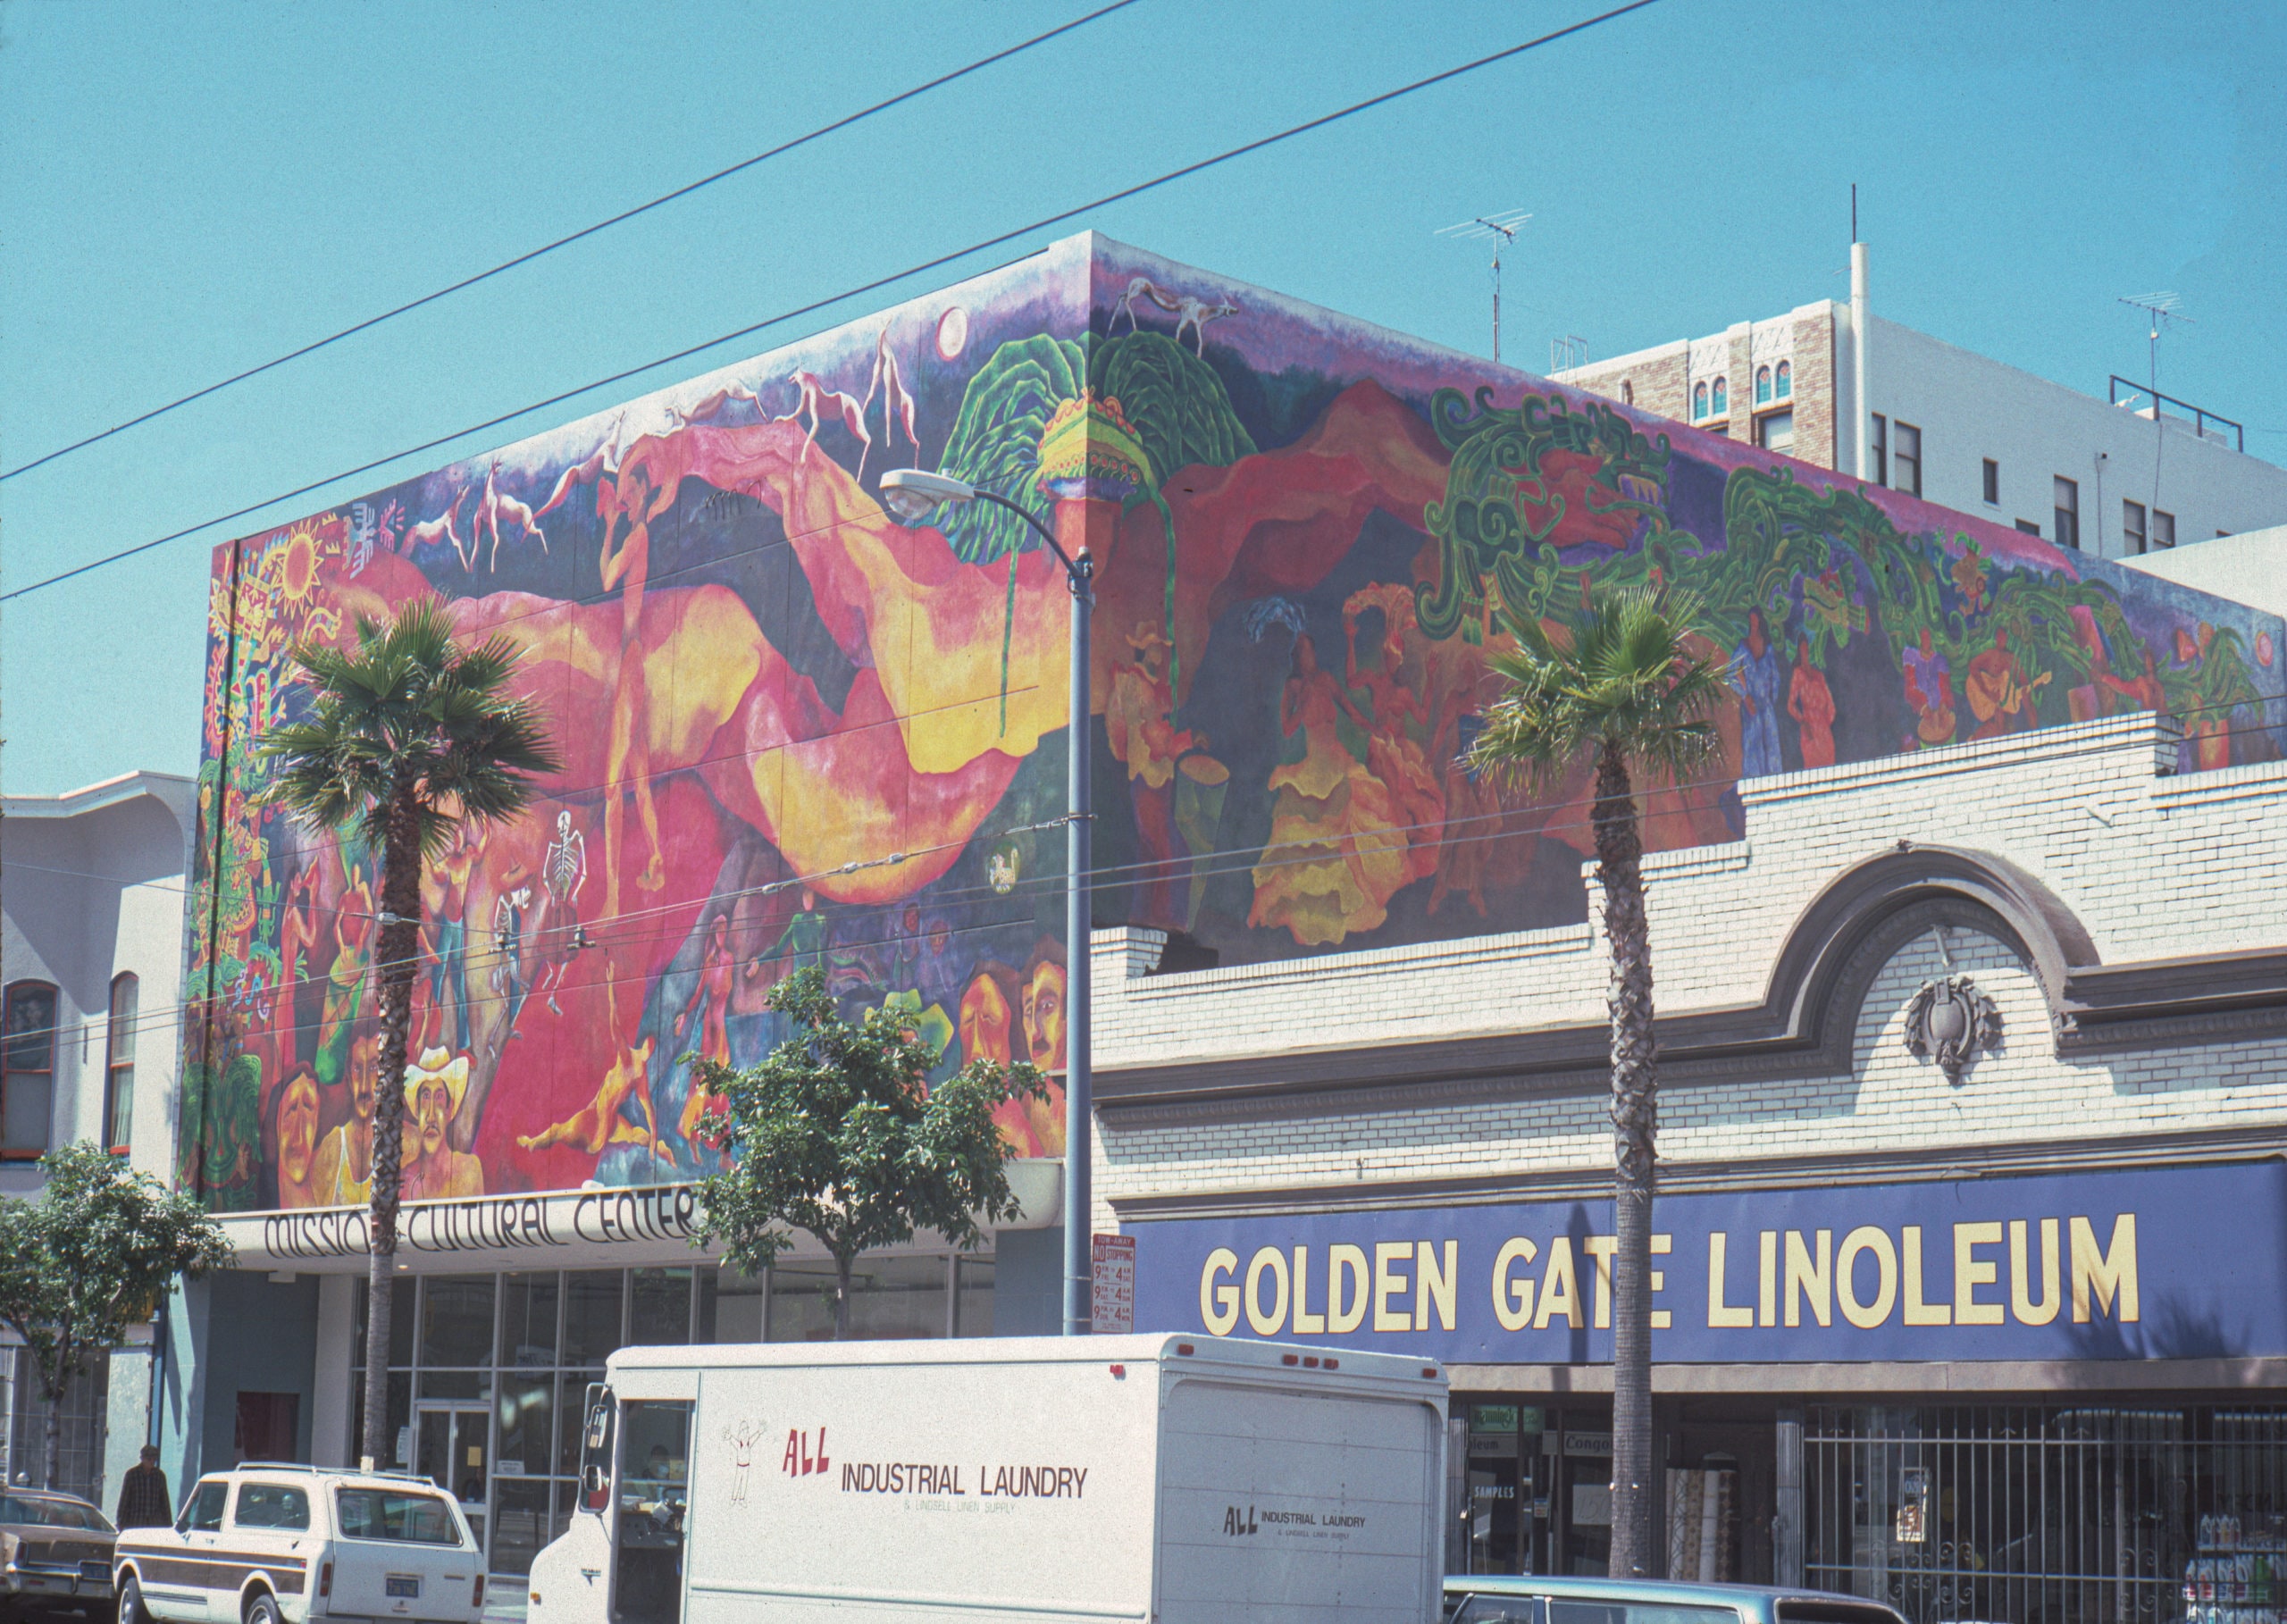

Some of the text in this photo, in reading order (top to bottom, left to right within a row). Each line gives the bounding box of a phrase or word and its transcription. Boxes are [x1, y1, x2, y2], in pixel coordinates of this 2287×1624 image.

[264, 1186, 699, 1258] MISSIO CULTURAL CENTER
[1098, 1235, 1131, 1245] TOW-AWAY
[1093, 1244, 1133, 1261] NO STOPPING
[1094, 1265, 1101, 1279] 9
[1116, 1267, 1122, 1282] 4
[1199, 1212, 2141, 1336] GOLDEN GATE LINOLEUM
[1094, 1285, 1101, 1299] 9
[1115, 1287, 1122, 1301] 4
[1094, 1305, 1100, 1318] 9
[1115, 1307, 1121, 1321] 4
[782, 1426, 1088, 1498] ALL INDUSTRIAL LAUNDRY
[1474, 1486, 1514, 1499] SAMPLES
[957, 1501, 979, 1512] LINEN
[984, 1502, 1016, 1514] SUPPLY
[1223, 1504, 1365, 1536] ALL INDUSTRIAL LAUNDRY
